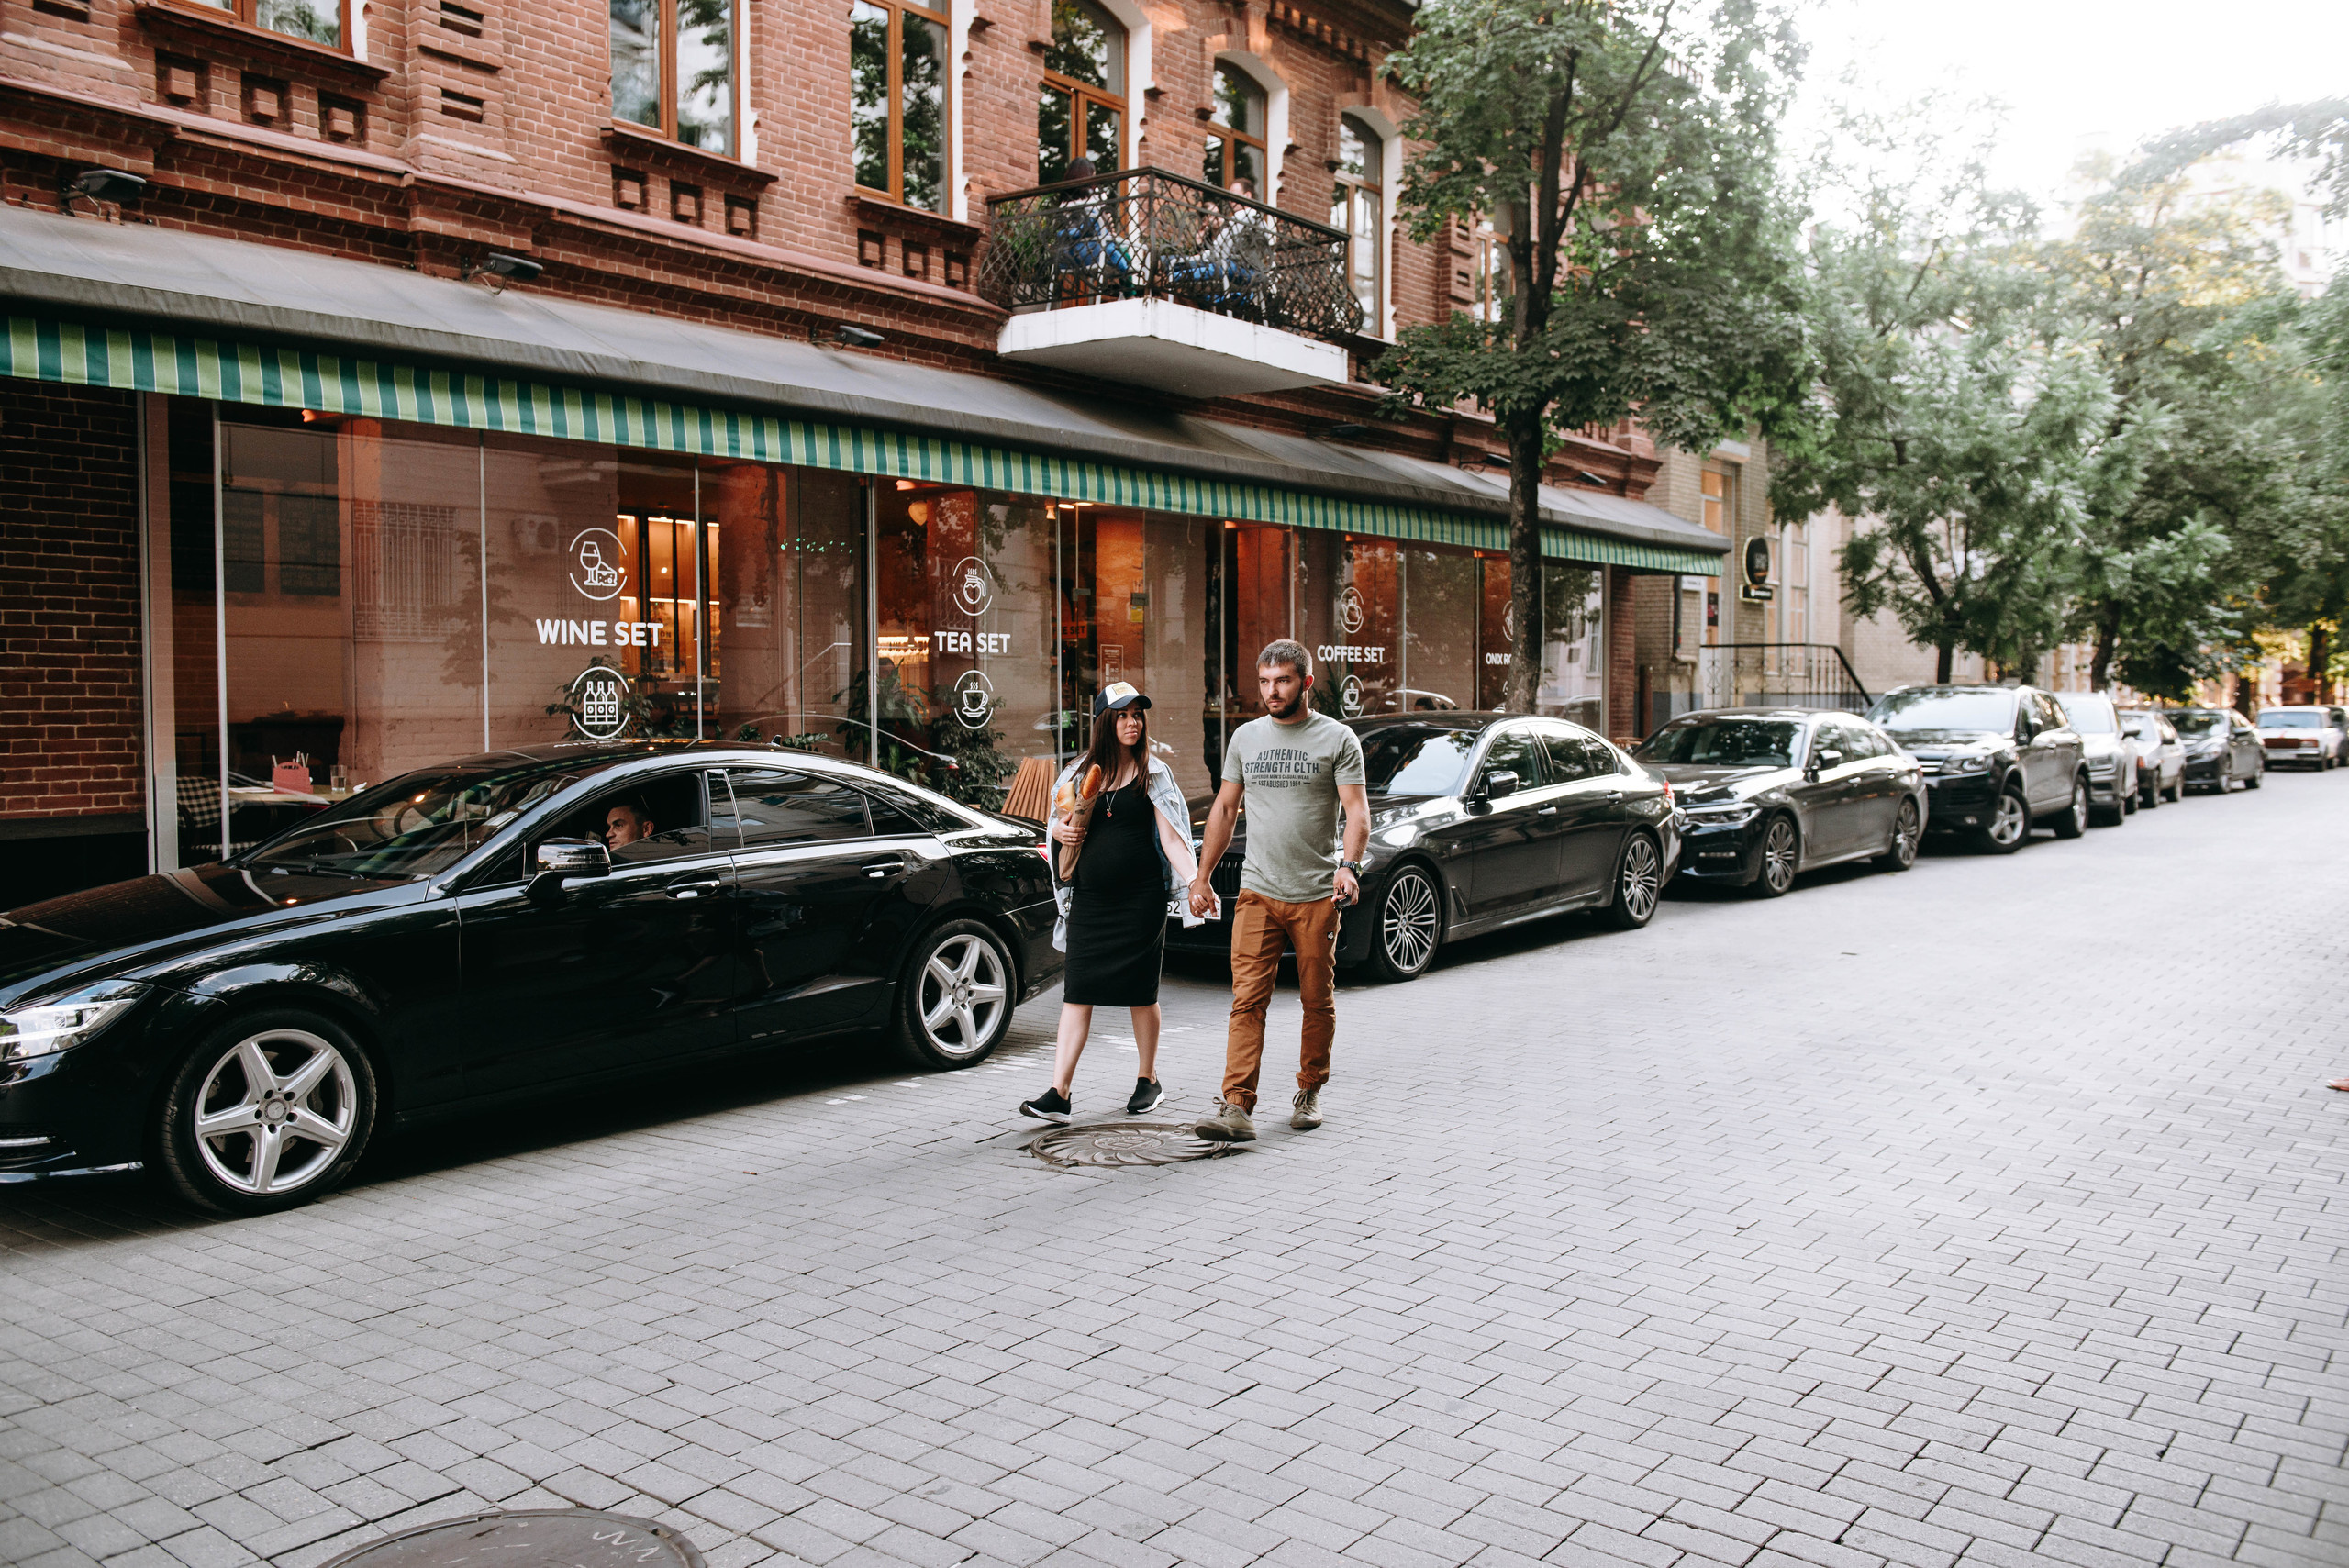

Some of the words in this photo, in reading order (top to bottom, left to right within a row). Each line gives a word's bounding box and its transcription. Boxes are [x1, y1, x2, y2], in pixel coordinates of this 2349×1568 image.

[536, 618, 607, 645] WINE
[614, 621, 664, 647] SET
[934, 631, 972, 652] TEA
[976, 632, 1011, 653] SET
[1317, 644, 1363, 662] COFFEE
[1364, 646, 1386, 662] SET
[1486, 652, 1503, 665] ONIX
[1256, 748, 1308, 762] AUTHENTIC
[1244, 762, 1291, 774] STRENGTH
[1294, 762, 1322, 774] CLTH.
[1258, 780, 1289, 788] ESTABLISHED
